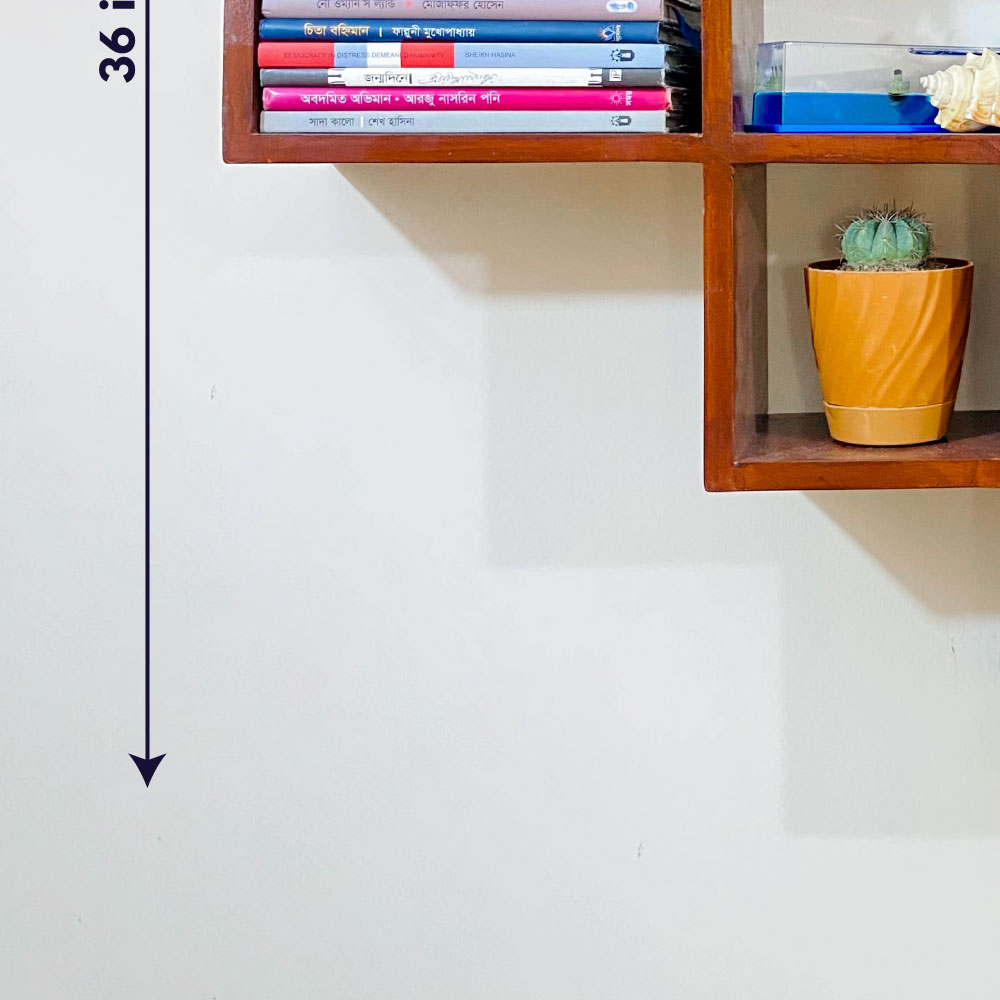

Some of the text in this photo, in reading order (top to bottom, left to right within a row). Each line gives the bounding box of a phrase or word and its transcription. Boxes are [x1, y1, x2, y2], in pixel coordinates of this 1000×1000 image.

[304, 23, 327, 36] চিতা
[301, 91, 347, 104] অবদমিত
[351, 92, 391, 105] অভিমান
[438, 92, 476, 105] নাসরিন
[480, 92, 501, 105] পনি
[309, 117, 328, 126] সাদা
[331, 116, 355, 126] কালো
[388, 116, 415, 126] হাসিনা
